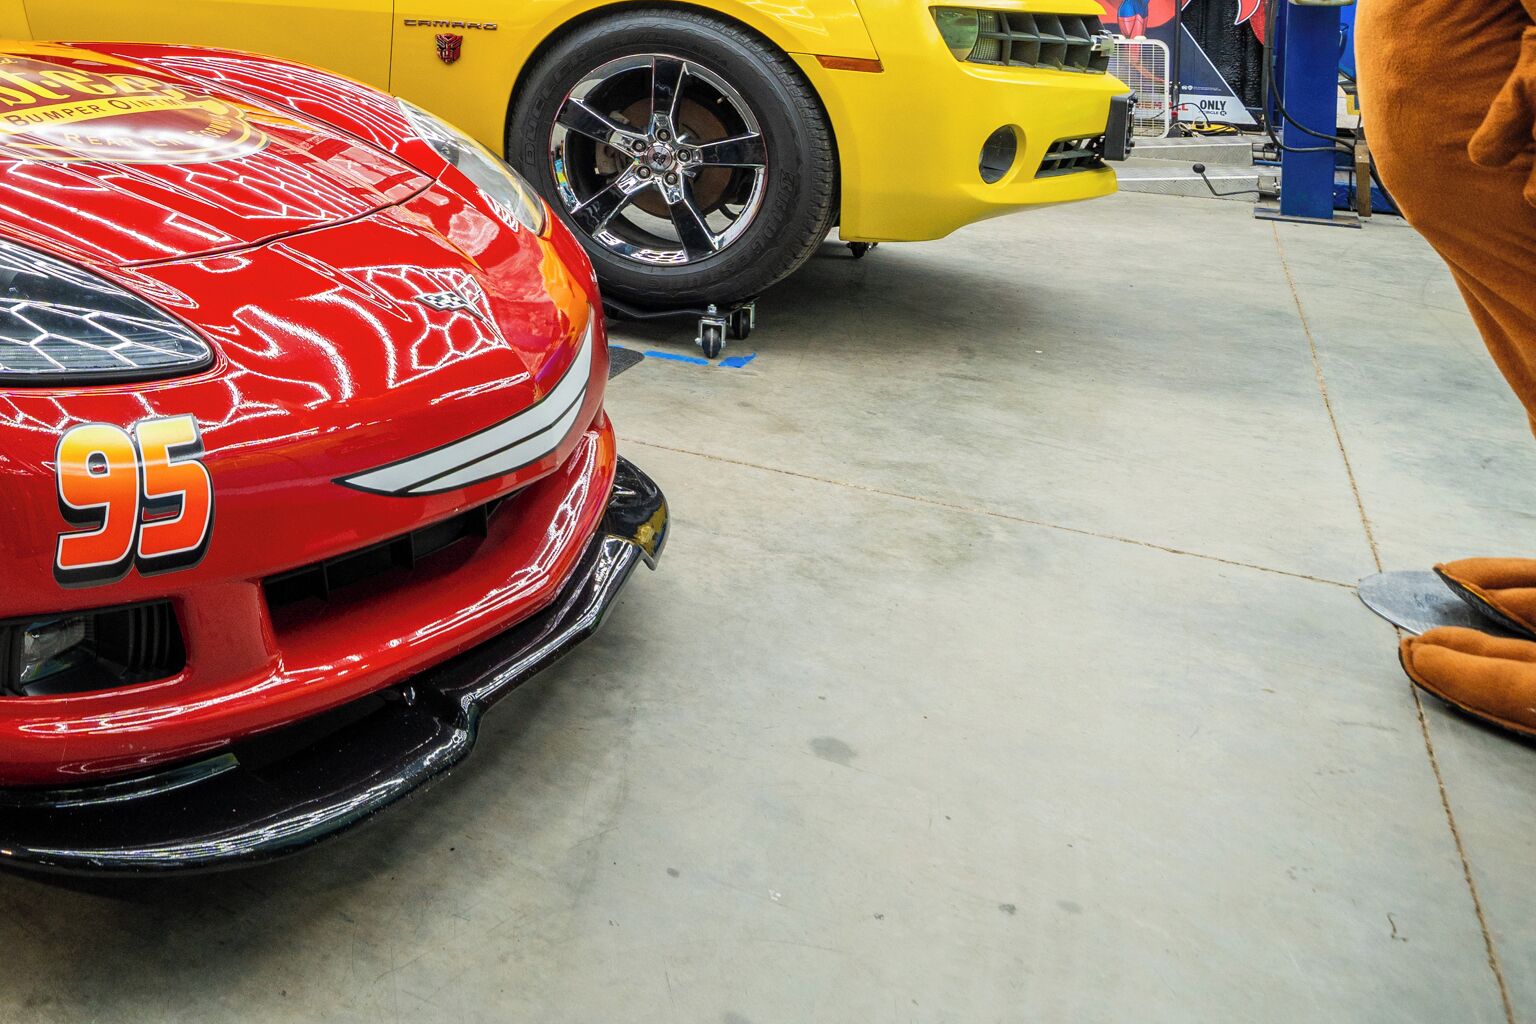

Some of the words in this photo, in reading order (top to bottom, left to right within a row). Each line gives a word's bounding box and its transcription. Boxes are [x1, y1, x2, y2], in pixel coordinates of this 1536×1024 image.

[404, 19, 497, 31] CAMARO
[1200, 99, 1227, 111] ONLY
[53, 414, 215, 582] 95
